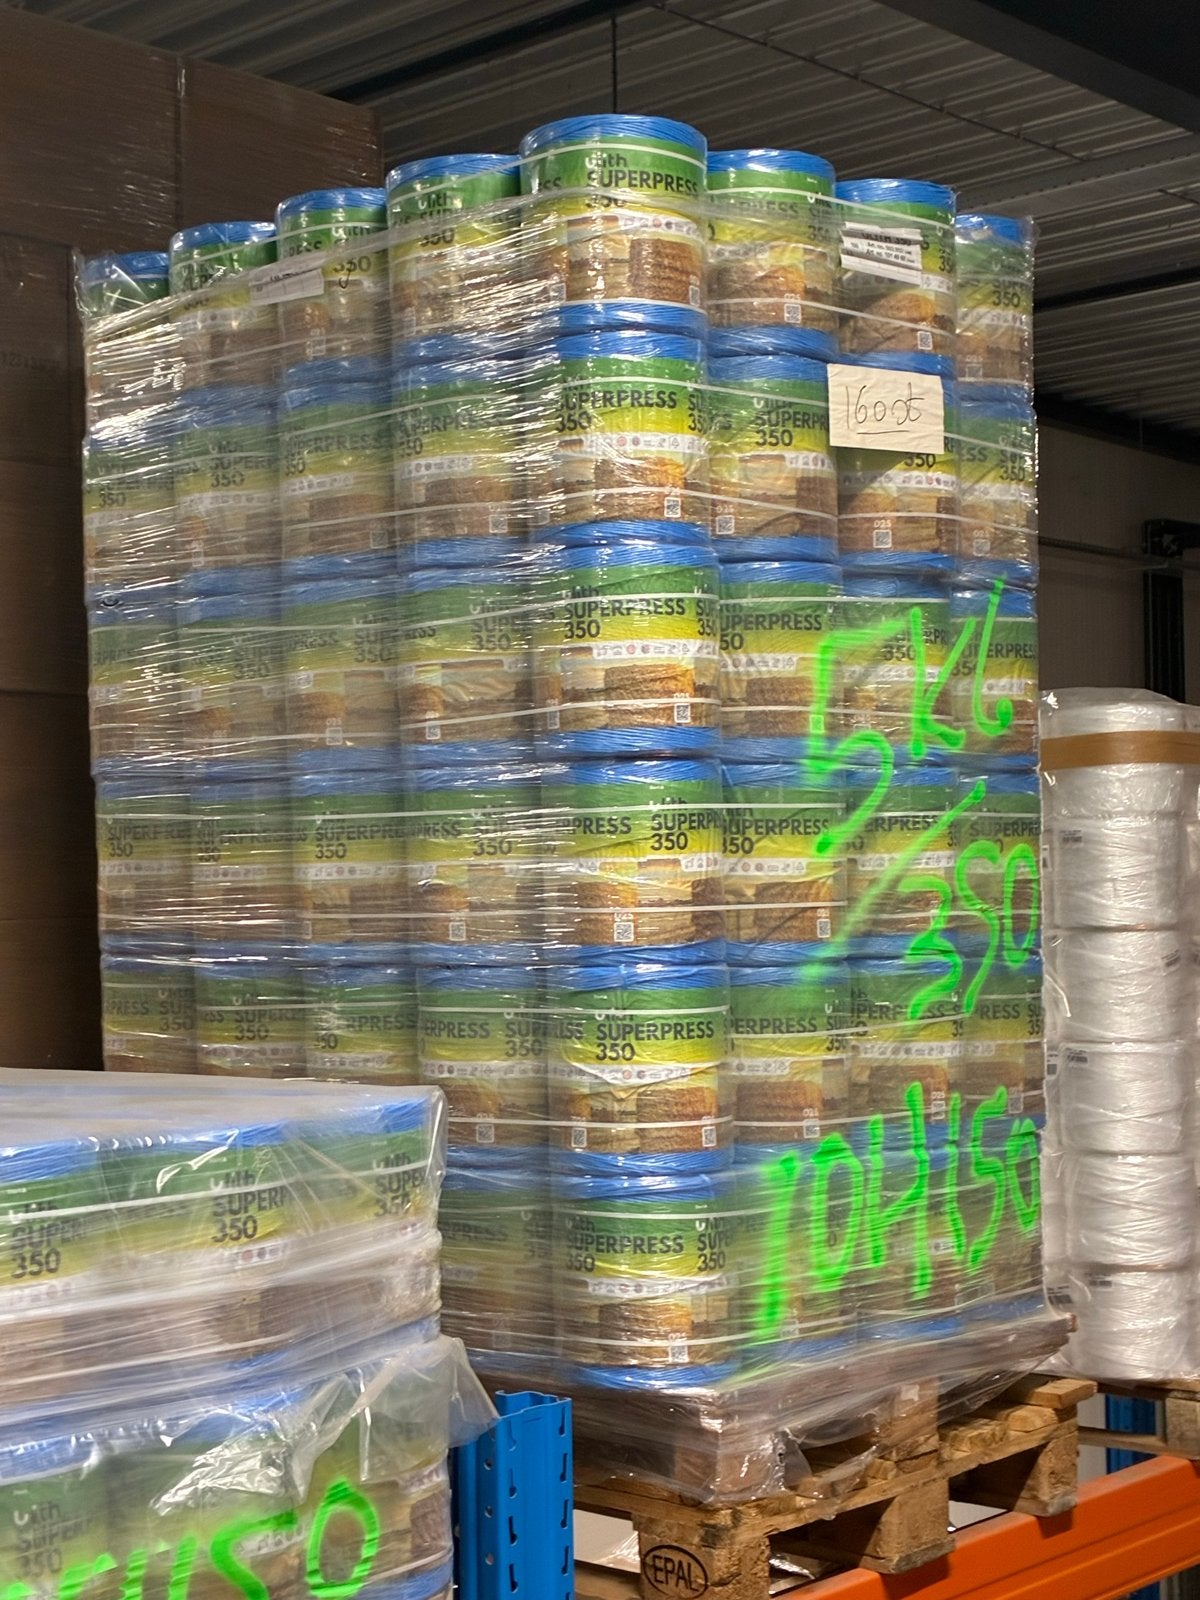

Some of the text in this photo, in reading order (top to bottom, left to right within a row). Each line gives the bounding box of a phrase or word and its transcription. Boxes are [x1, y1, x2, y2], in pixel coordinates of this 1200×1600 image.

[585, 170, 698, 193] SUPERPRESS
[755, 429, 794, 447] 350
[563, 598, 686, 620] SUPERPRESS
[564, 619, 601, 640] 350
[110, 840, 133, 858] 350
[315, 841, 347, 859] 350
[650, 831, 688, 852] 350
[595, 1021, 714, 1042] SUPERPRESS
[505, 1038, 543, 1058] 350
[595, 1042, 635, 1062] 350
[211, 1214, 259, 1243] 350
[566, 1233, 685, 1254] SUPERPRESS
[11, 1247, 62, 1280] 350
[697, 1251, 726, 1272] 350
[651, 1554, 700, 1592] EPAL
